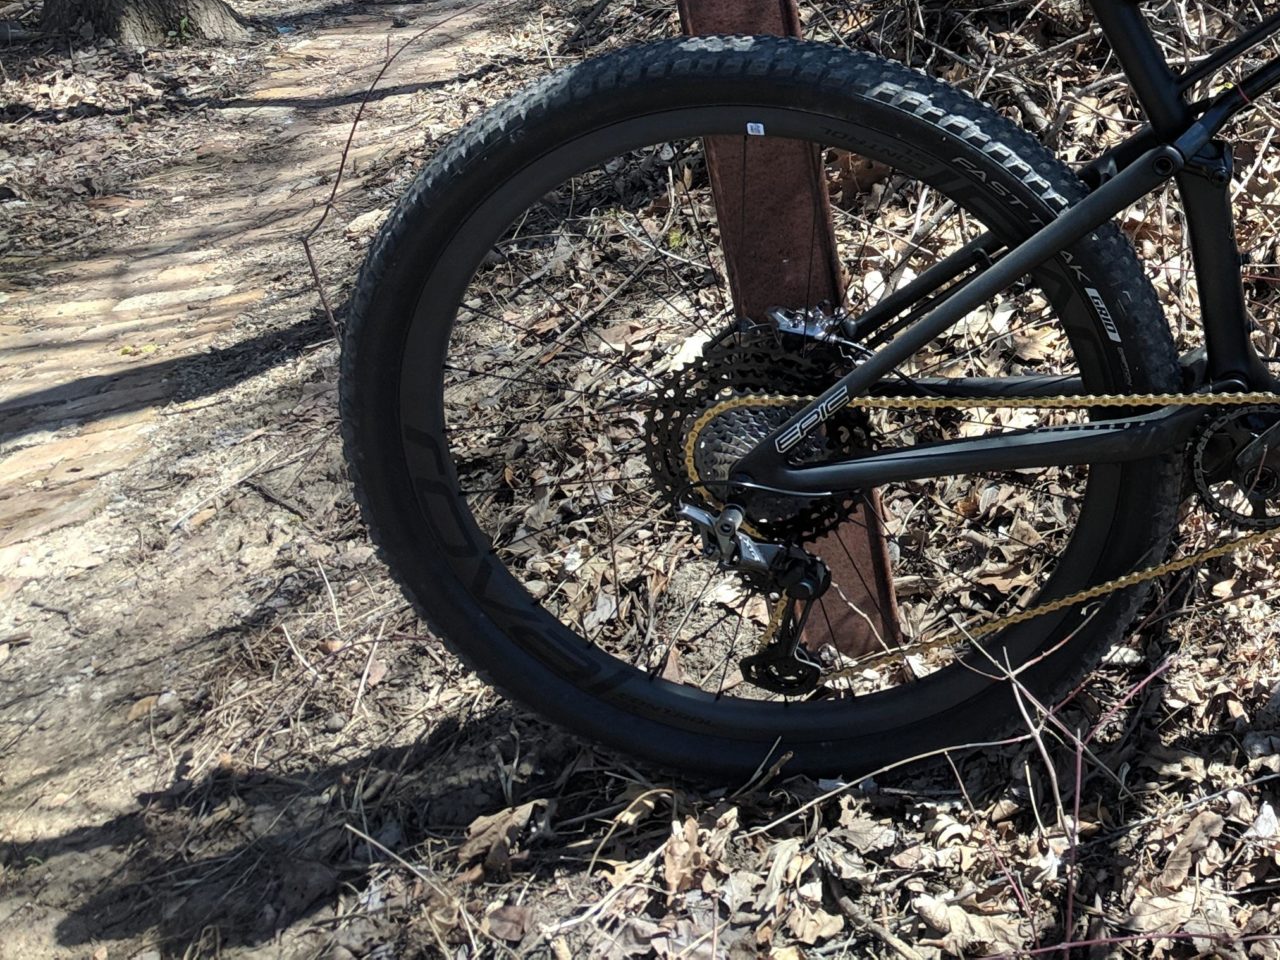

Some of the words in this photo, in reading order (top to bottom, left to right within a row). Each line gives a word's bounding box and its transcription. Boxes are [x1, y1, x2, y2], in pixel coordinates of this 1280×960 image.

[951, 156, 1028, 212] FAST
[1030, 215, 1093, 283] TAK
[774, 384, 850, 454] EPIC
